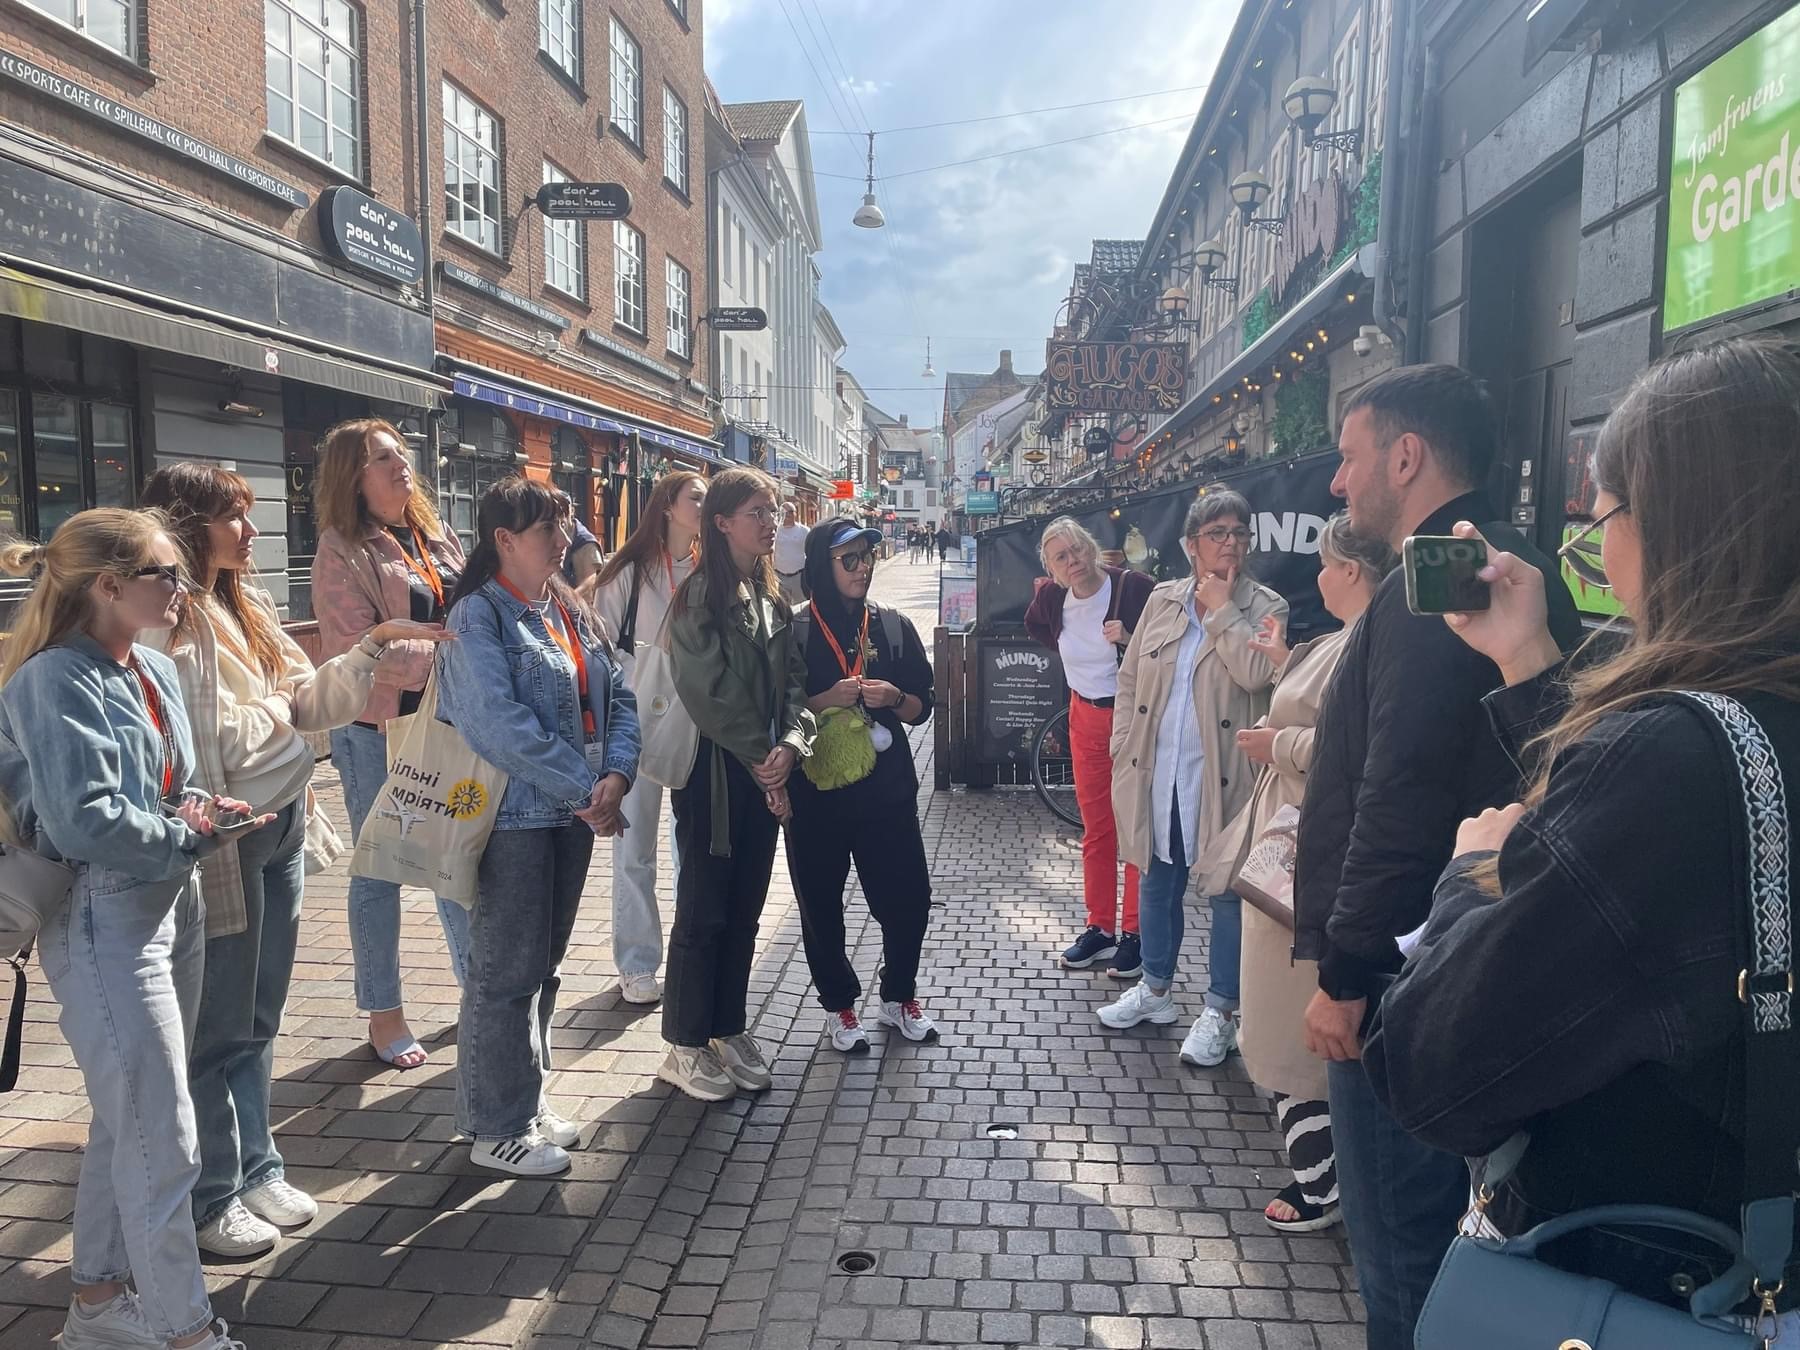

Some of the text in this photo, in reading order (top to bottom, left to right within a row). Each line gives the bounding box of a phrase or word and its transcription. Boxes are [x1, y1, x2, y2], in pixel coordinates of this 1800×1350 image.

[16, 62, 295, 202] SPORTS CAFE SPILLEHAL POOL HALL SPORTS CAFE
[1684, 73, 1787, 188] Jomfruens
[360, 202, 398, 231] dan's
[346, 222, 415, 262] pool hall
[391, 786, 457, 819] мріяти
[437, 870, 452, 881] 2024
